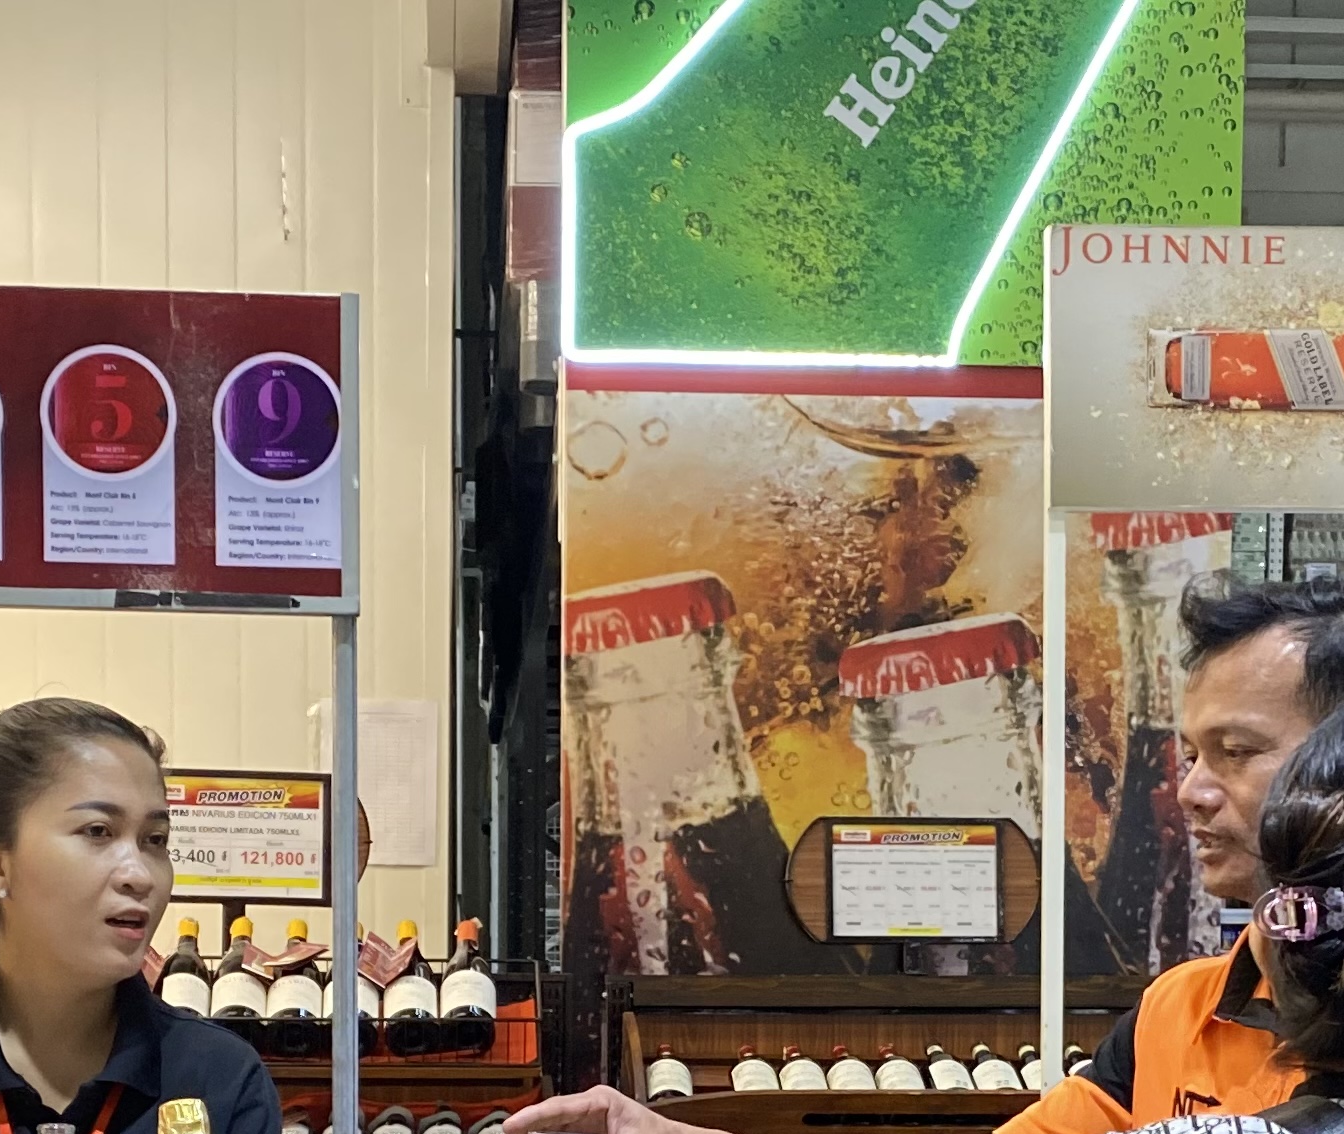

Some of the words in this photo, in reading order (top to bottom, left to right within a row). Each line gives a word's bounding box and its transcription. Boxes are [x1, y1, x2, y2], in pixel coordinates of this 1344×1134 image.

[824, 0, 974, 148] Hein
[1053, 227, 1286, 276] JOHNNIE
[1301, 332, 1318, 364] GOLD
[1313, 366, 1333, 405] LABEL
[91, 375, 132, 441] 5
[258, 379, 301, 444] 9
[198, 790, 283, 802] PROMOTION
[192, 810, 235, 818] NIVARIUS
[238, 811, 276, 820] EDICION
[230, 826, 264, 834] LIMITADA
[883, 833, 961, 842] PROMOTION
[168, 850, 215, 864] 3,400
[241, 851, 304, 867] 121,800
